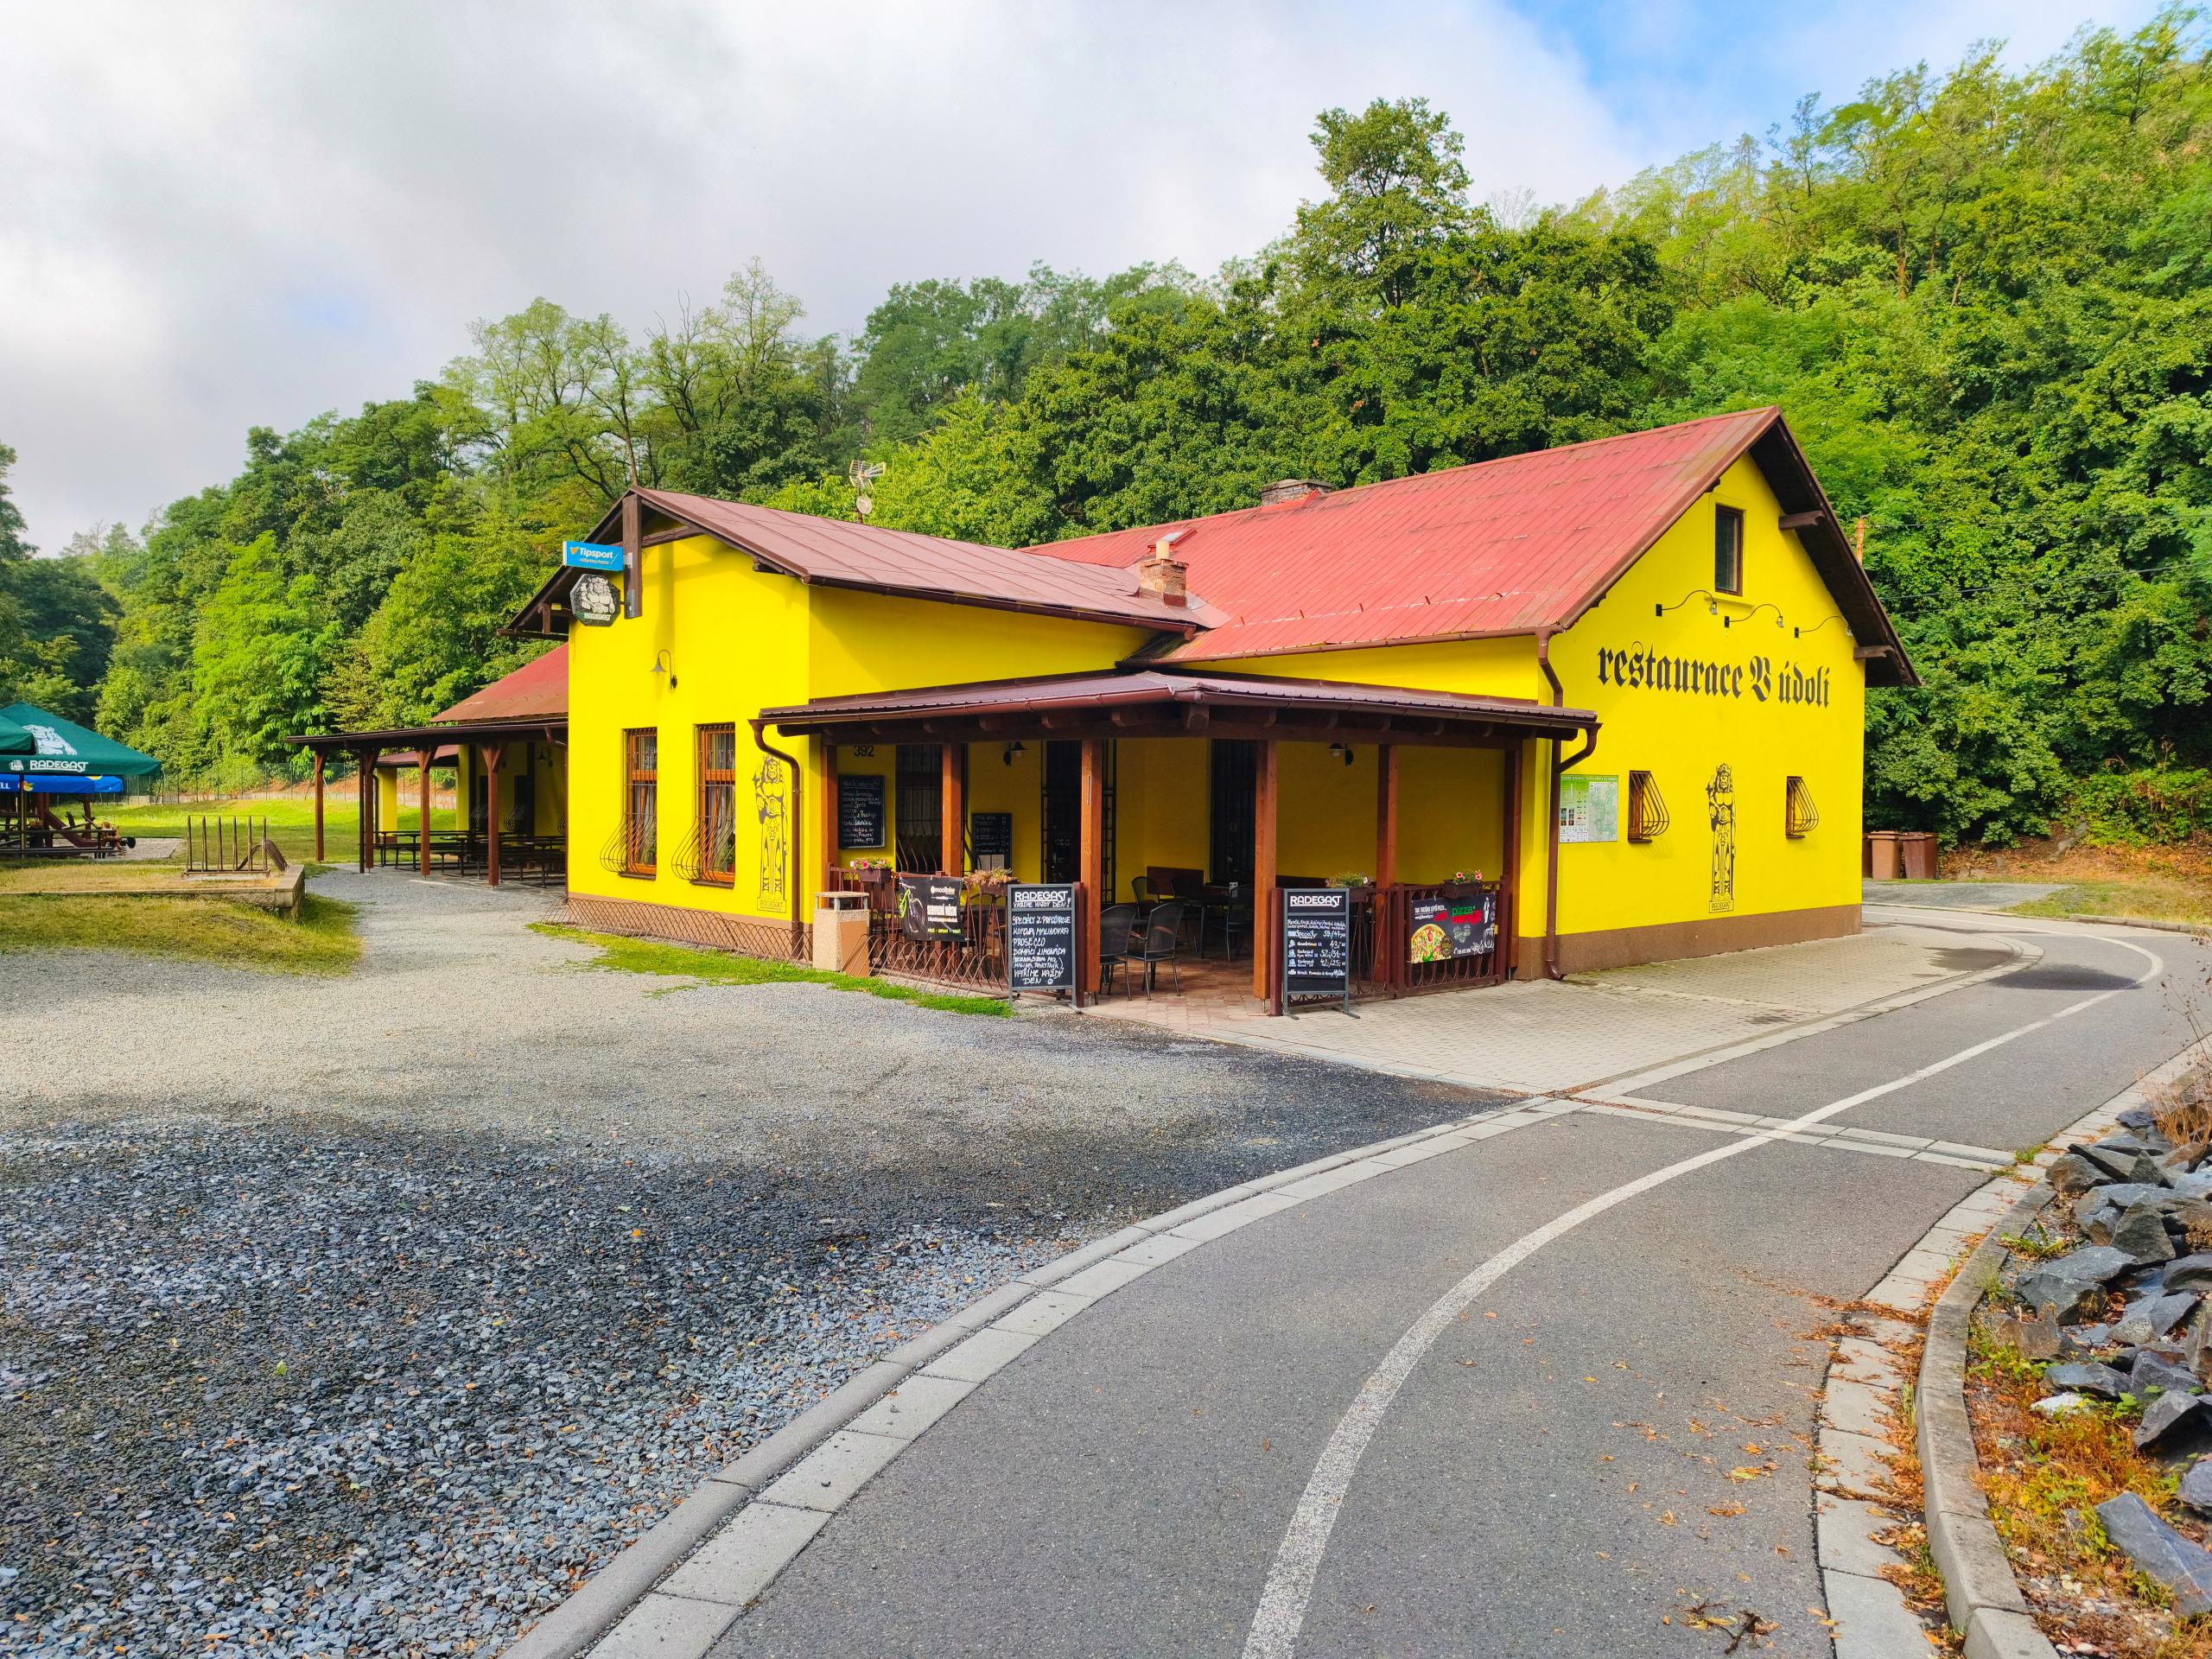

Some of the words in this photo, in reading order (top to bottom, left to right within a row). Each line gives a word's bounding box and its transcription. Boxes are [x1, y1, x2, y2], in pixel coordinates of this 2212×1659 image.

[579, 547, 613, 559] Tipsport
[1598, 640, 1743, 699] restaurace
[1750, 655, 1772, 702] V
[1777, 660, 1830, 709] údolí
[854, 745, 874, 757] 392
[29, 760, 89, 772] RADEGAST
[1014, 891, 1068, 903] RADEGAST
[1290, 895, 1342, 907] RADEGAST
